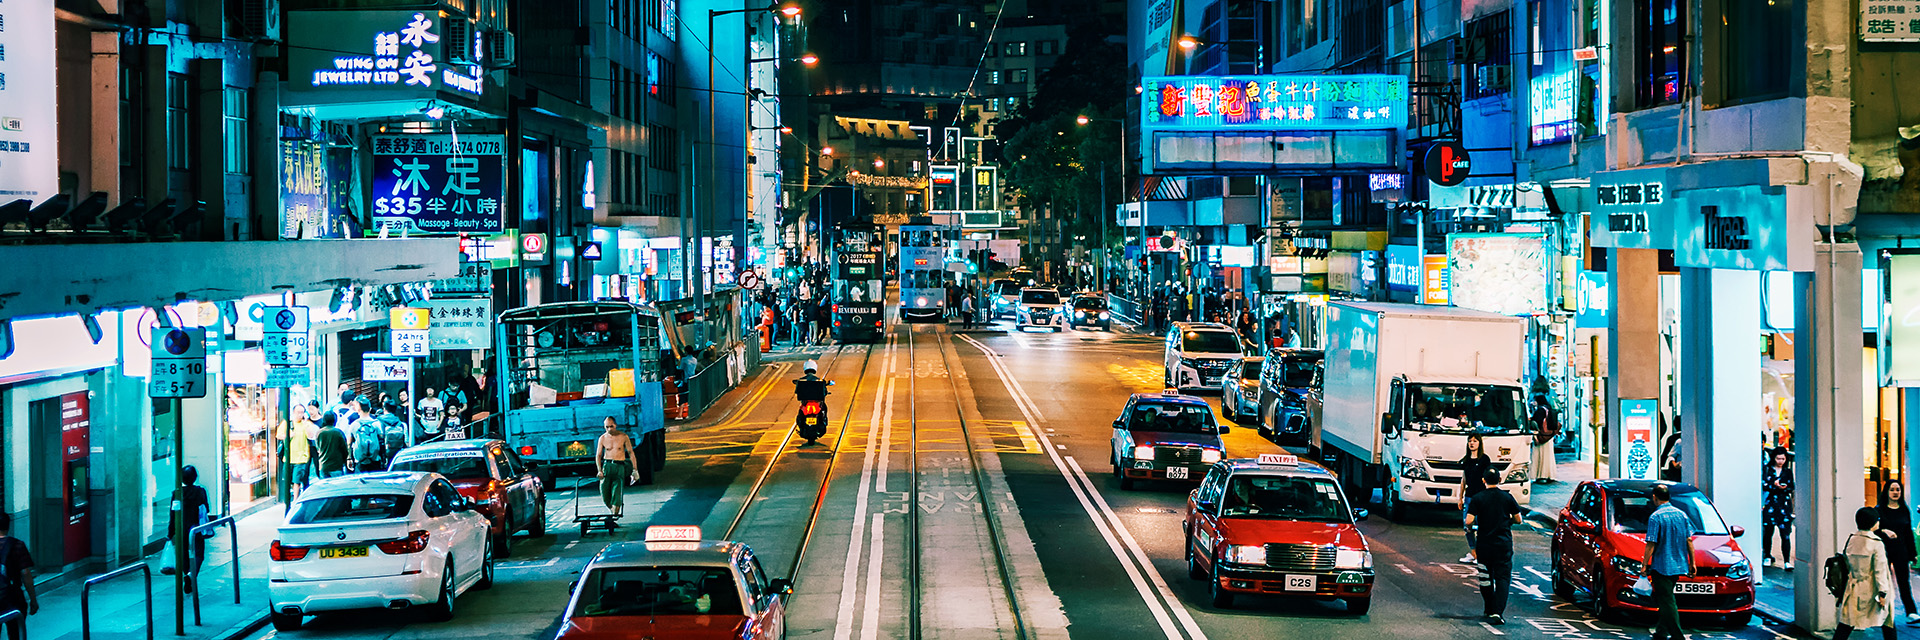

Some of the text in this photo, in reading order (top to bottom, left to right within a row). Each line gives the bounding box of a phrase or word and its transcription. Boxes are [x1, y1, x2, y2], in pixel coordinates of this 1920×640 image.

[400, 13, 440, 88] 永安
[335, 57, 399, 69] WING ON
[313, 71, 400, 86] JEWELRY LTD
[1161, 84, 1244, 118] 新豐記
[376, 138, 427, 154] 泰舒適
[476, 141, 500, 154] 0778
[1453, 161, 1470, 169] CAFE
[392, 157, 481, 196] 沐足
[375, 197, 498, 215] $35 半小時
[400, 343, 422, 353] 全日
[153, 367, 168, 375] 上午
[1261, 455, 1282, 463] TAXI
[651, 528, 696, 539] TAXI
[338, 547, 367, 557] 3438
[1290, 578, 1312, 588] C2S
[1685, 583, 1713, 593] 5892
